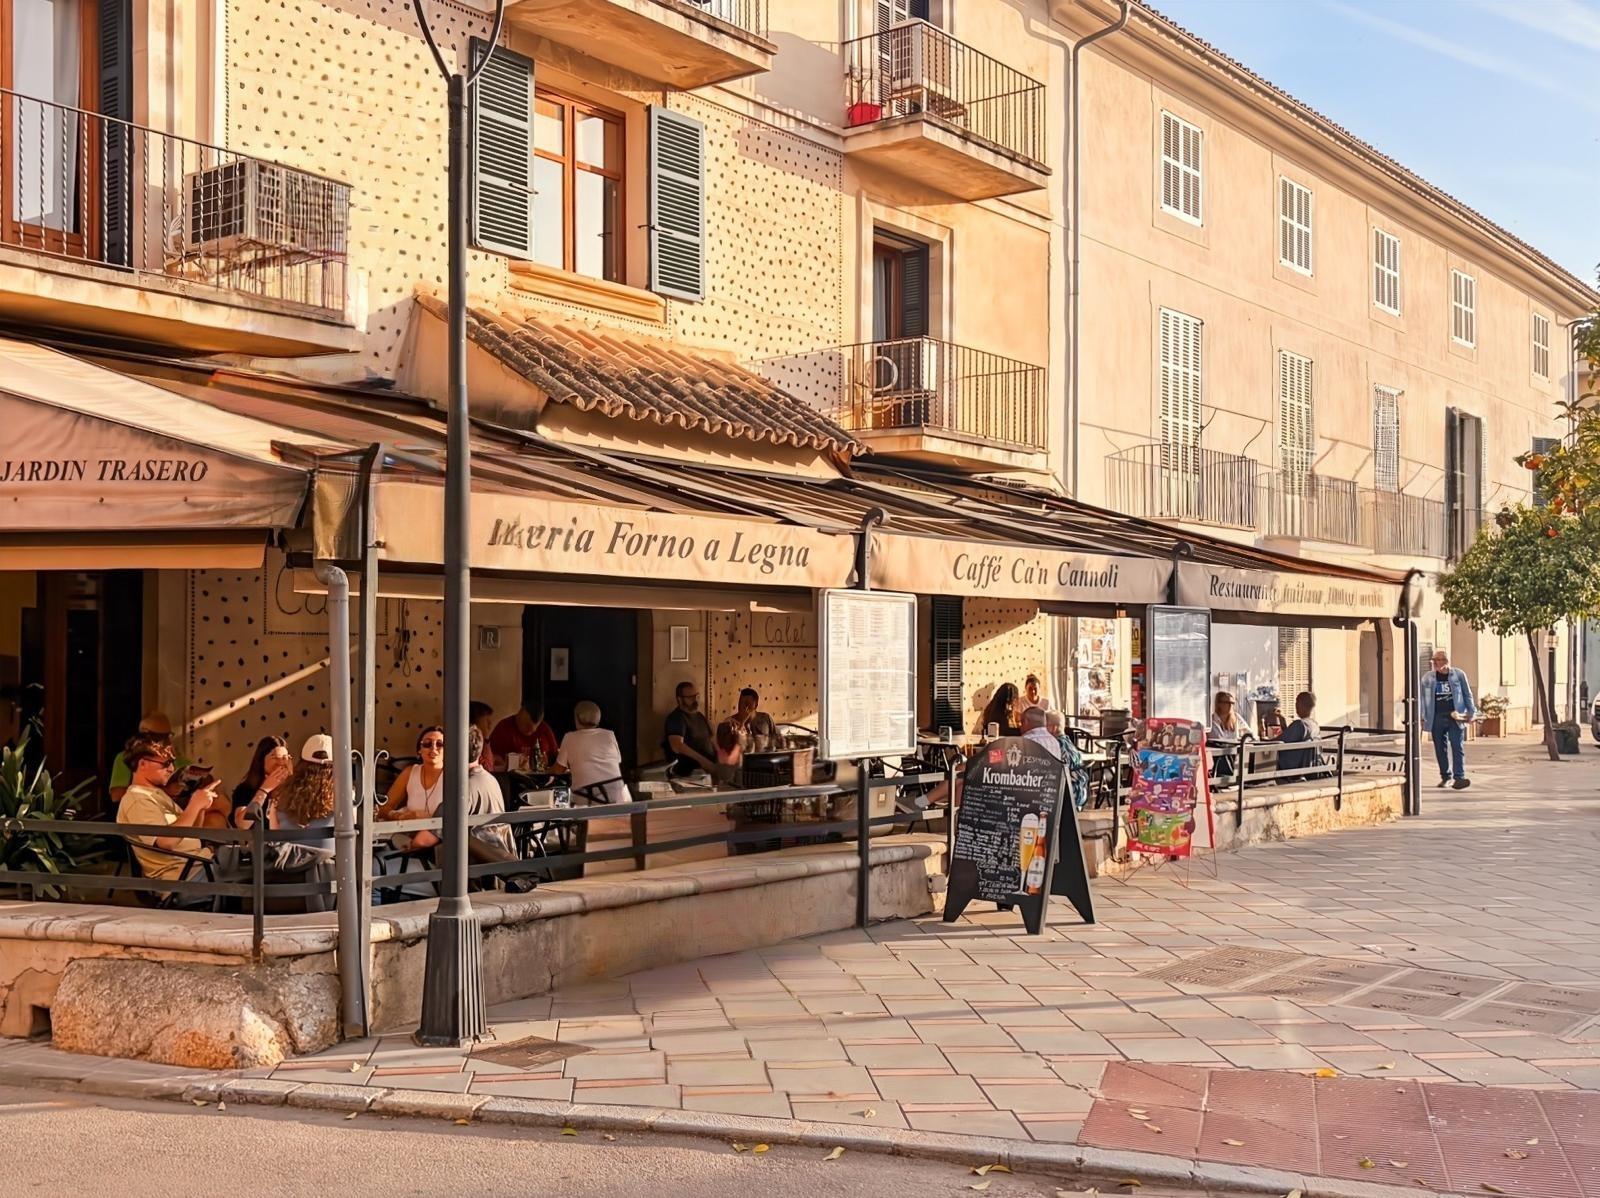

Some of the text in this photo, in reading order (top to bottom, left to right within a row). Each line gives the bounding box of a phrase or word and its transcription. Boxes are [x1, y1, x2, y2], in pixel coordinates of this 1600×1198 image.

[0, 460, 209, 482] JARDIN TRASERO
[605, 521, 695, 559] Forno
[703, 538, 720, 561] a
[727, 532, 810, 574] Legna
[953, 553, 1119, 589] Caffé Ca'n Cannoli
[982, 767, 1044, 788] Krombacher
